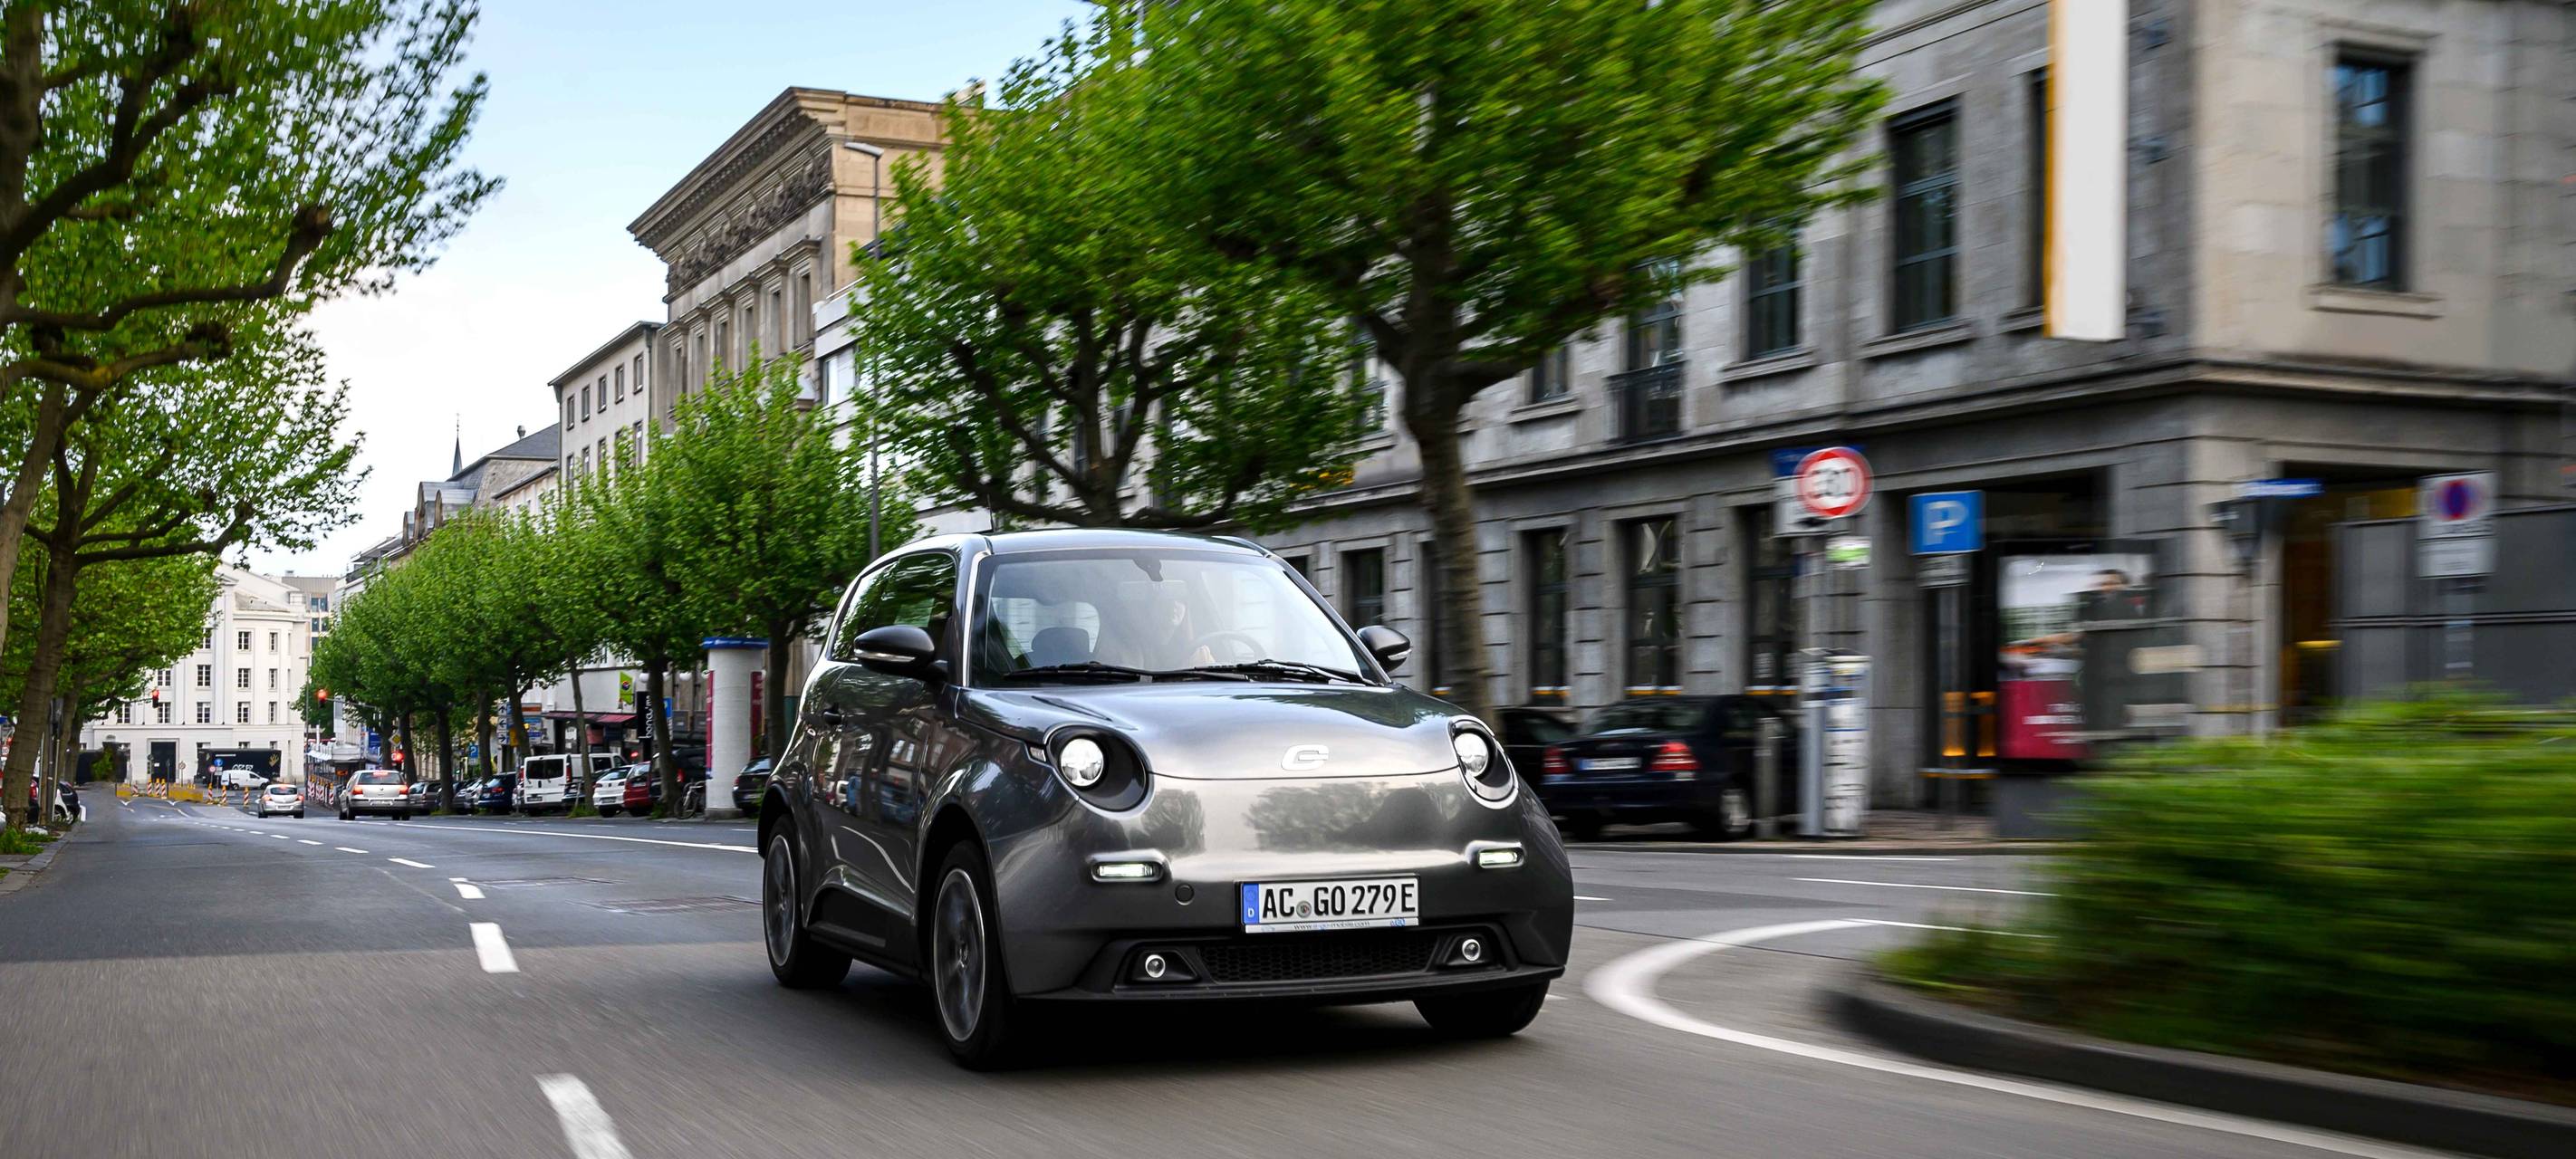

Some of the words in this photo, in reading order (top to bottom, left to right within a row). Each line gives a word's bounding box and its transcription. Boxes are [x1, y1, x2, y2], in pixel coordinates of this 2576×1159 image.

[1922, 501, 1969, 545] P
[1247, 907, 1254, 917] D
[1262, 888, 1294, 918] AC
[1313, 886, 1345, 915] GO
